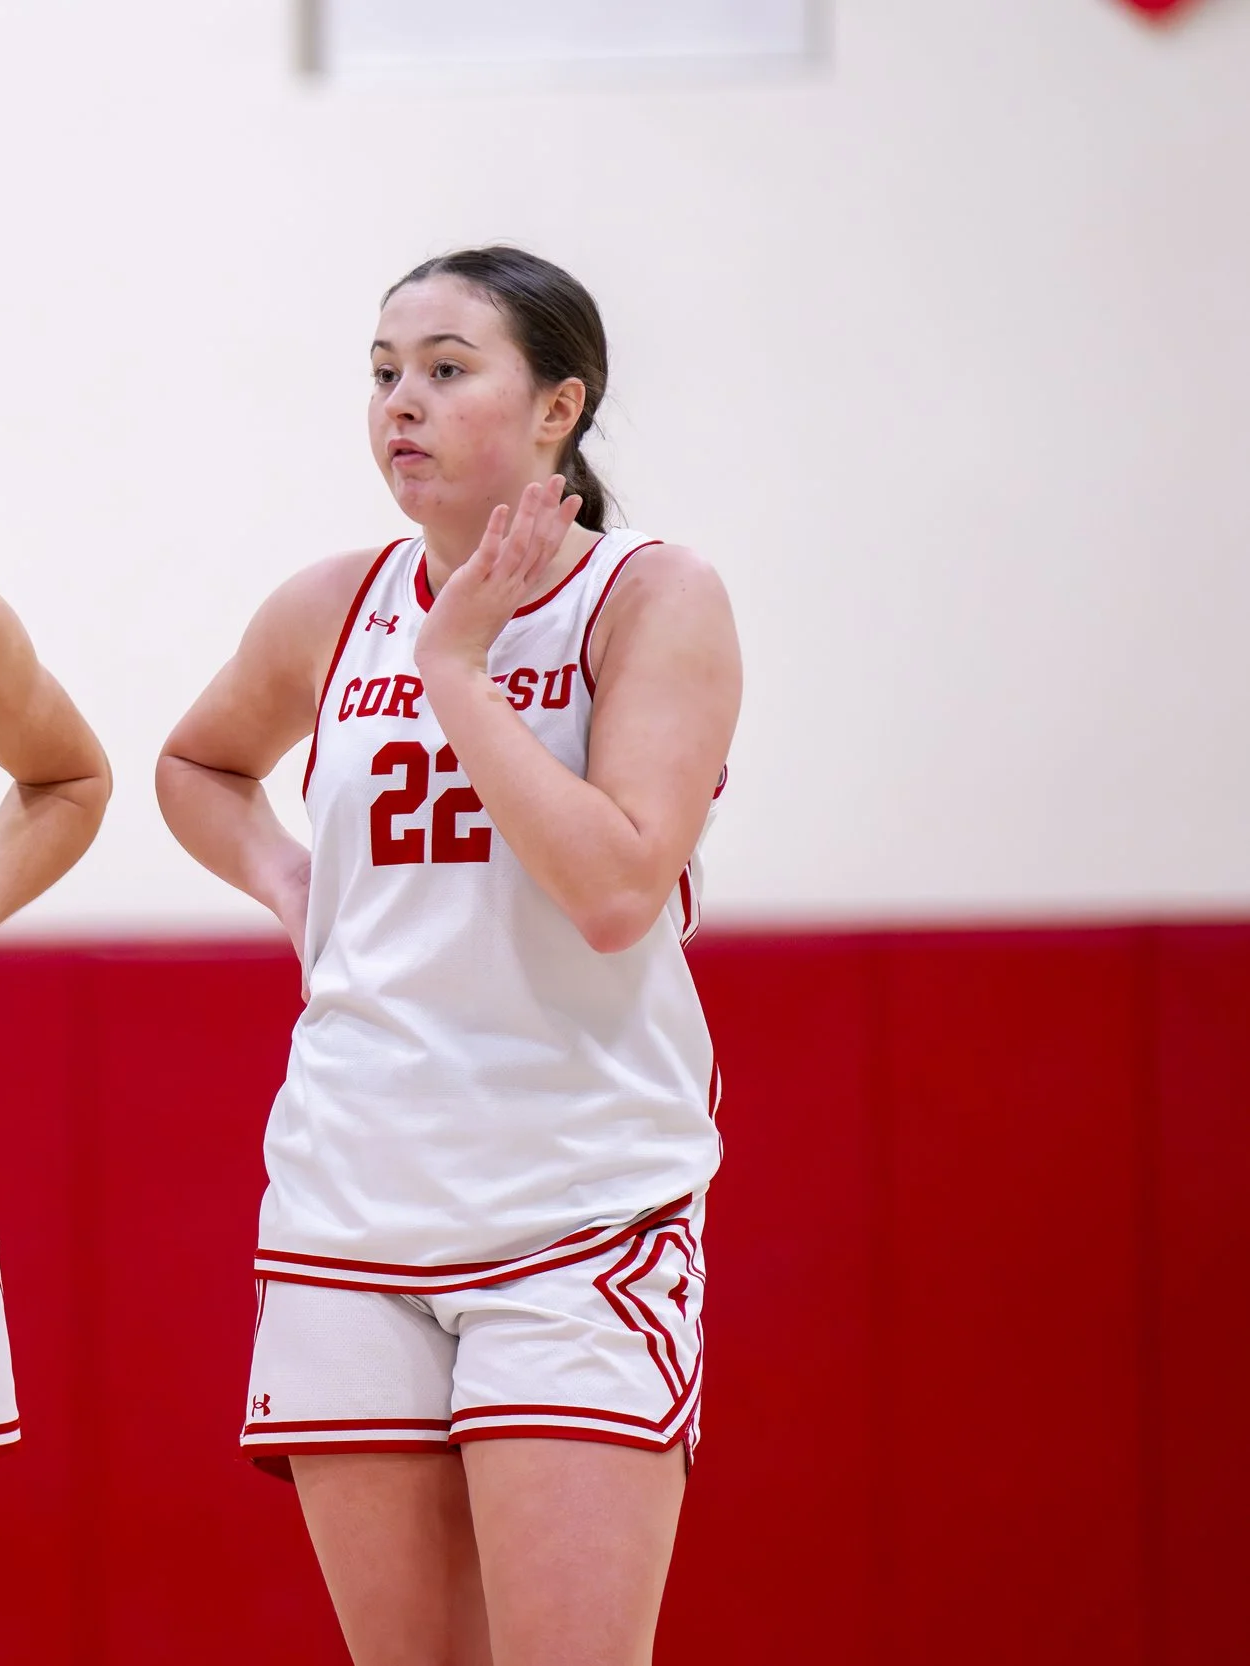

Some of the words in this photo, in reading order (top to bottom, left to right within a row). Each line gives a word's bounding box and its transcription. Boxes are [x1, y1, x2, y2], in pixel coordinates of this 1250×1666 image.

[337, 673, 423, 722] COR
[491, 663, 578, 711] SU
[370, 741, 492, 866] 22
